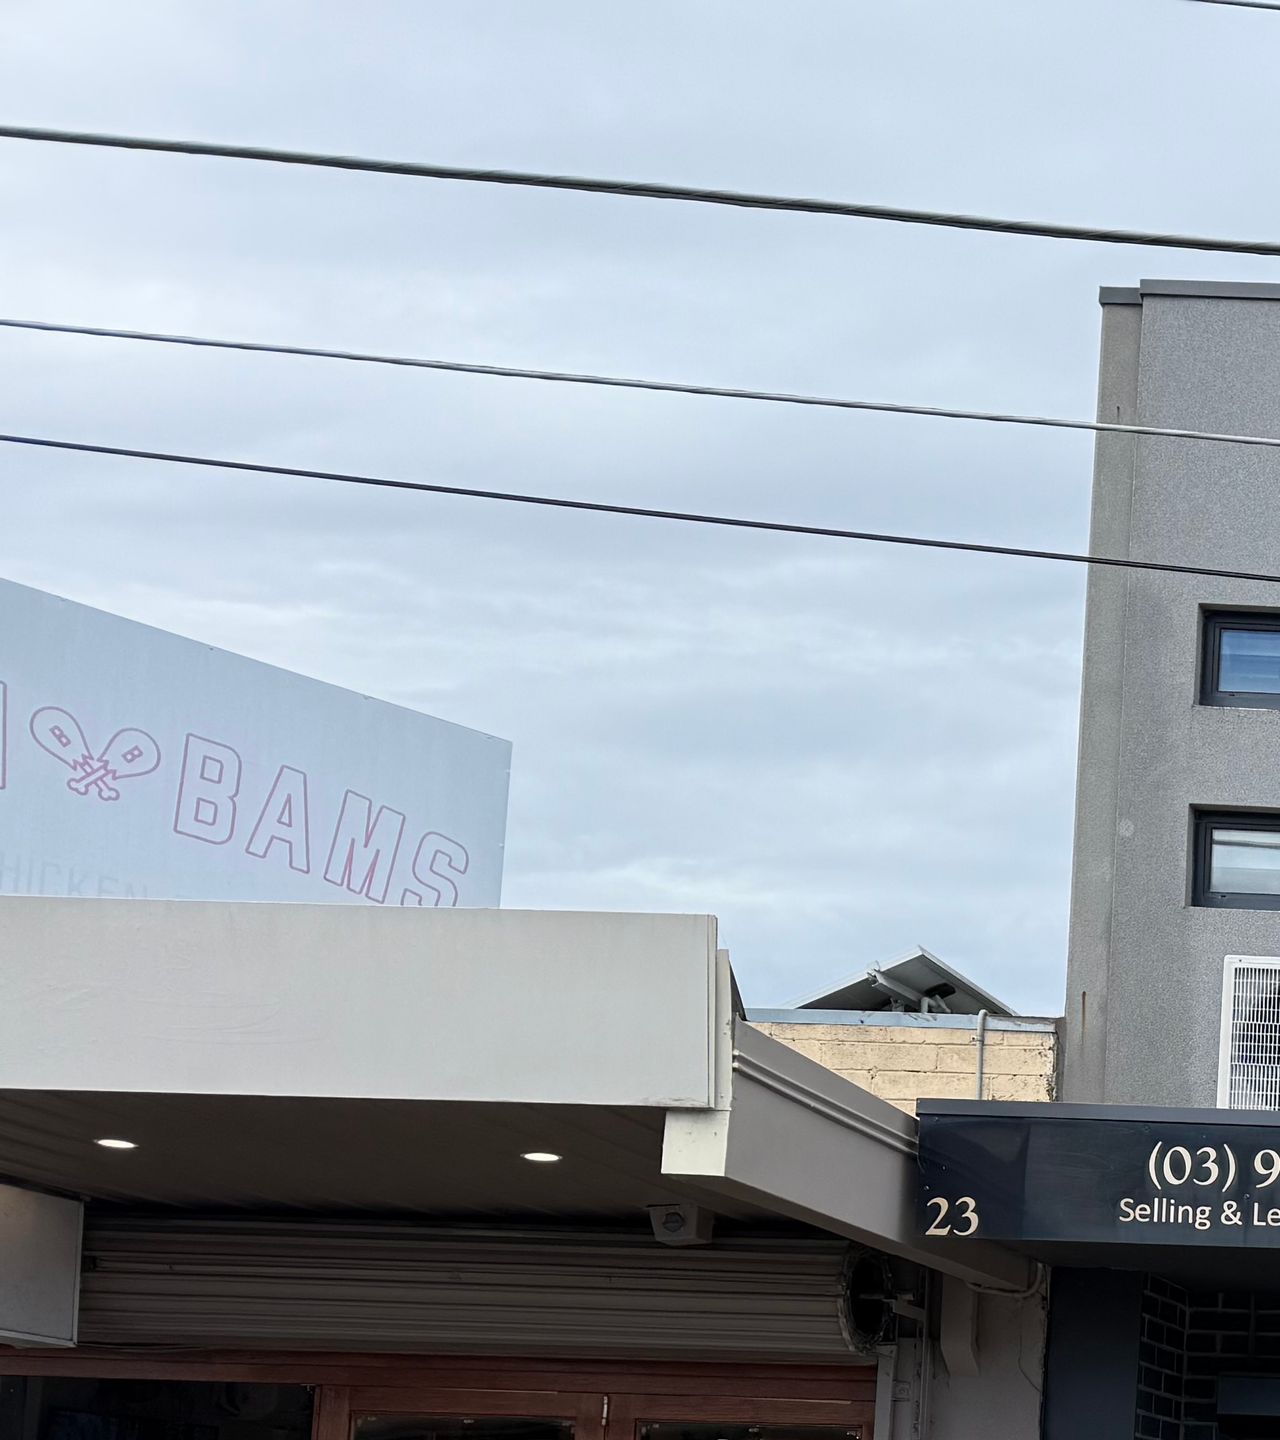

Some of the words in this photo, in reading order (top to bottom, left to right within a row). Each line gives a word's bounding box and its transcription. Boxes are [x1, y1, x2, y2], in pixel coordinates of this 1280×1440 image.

[173, 732, 470, 907] BAMS
[1148, 1141, 1237, 1193] (03)
[925, 1196, 979, 1236] 23
[1119, 1197, 1212, 1230] Selling
[1220, 1200, 1243, 1226] &
